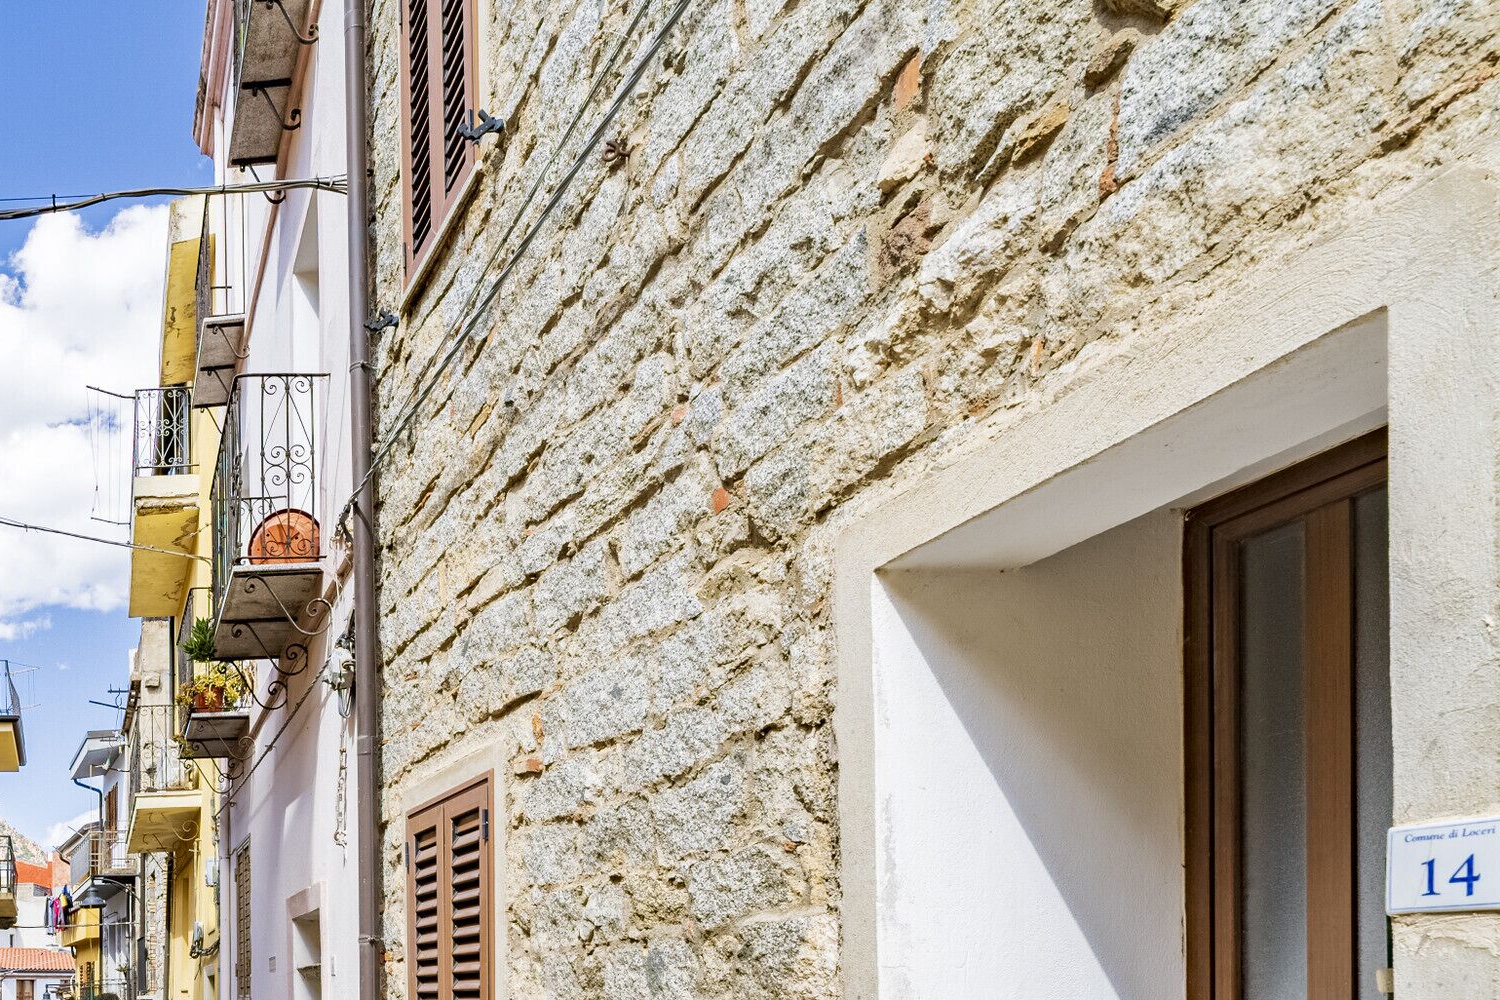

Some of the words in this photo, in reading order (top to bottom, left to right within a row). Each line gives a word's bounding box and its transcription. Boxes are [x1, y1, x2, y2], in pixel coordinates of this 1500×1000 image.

[1404, 833, 1444, 843] Comune
[1448, 828, 1458, 839] di
[1462, 825, 1496, 837] Loceri
[1420, 853, 1481, 896] 14
